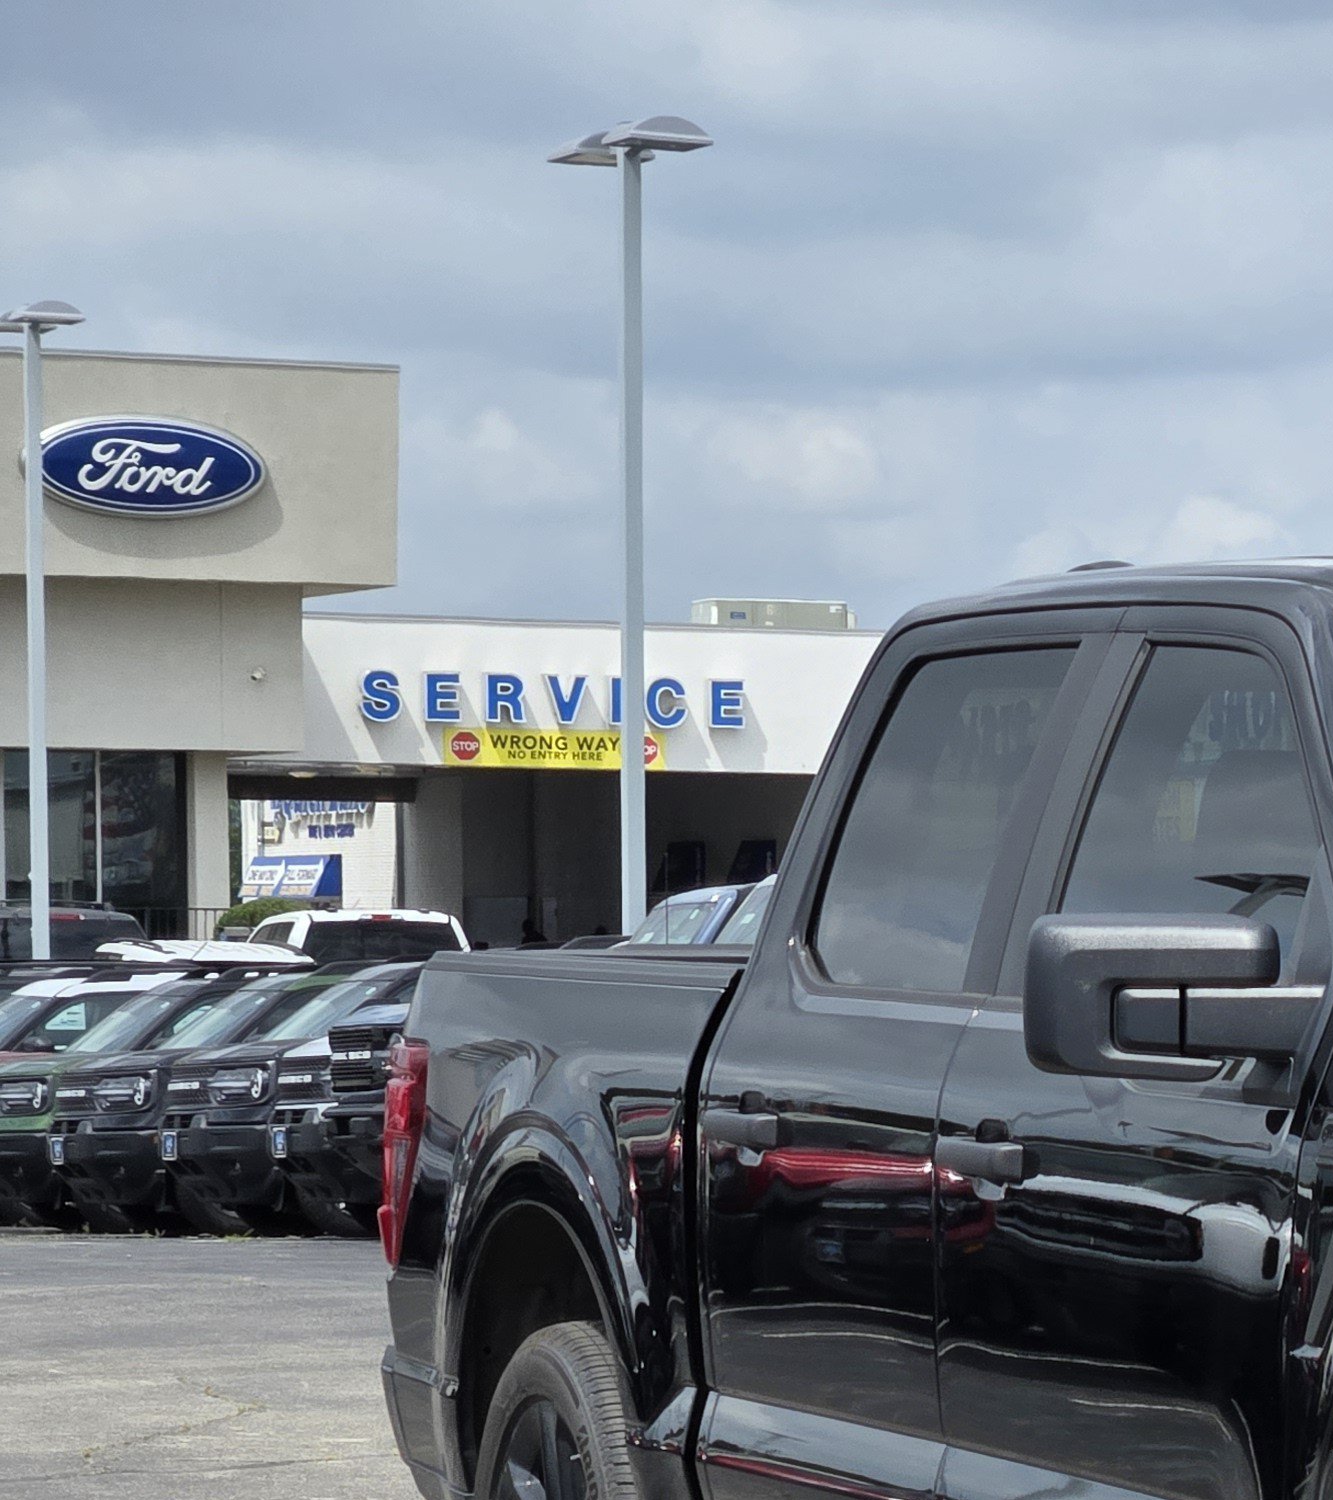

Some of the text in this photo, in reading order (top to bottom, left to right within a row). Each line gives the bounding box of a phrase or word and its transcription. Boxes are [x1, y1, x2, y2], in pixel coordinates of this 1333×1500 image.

[77, 437, 216, 496] Ford
[360, 670, 746, 729] SERVICE
[489, 735, 620, 751] WRONG WAY
[508, 750, 603, 761] NO ENTRY HERE
